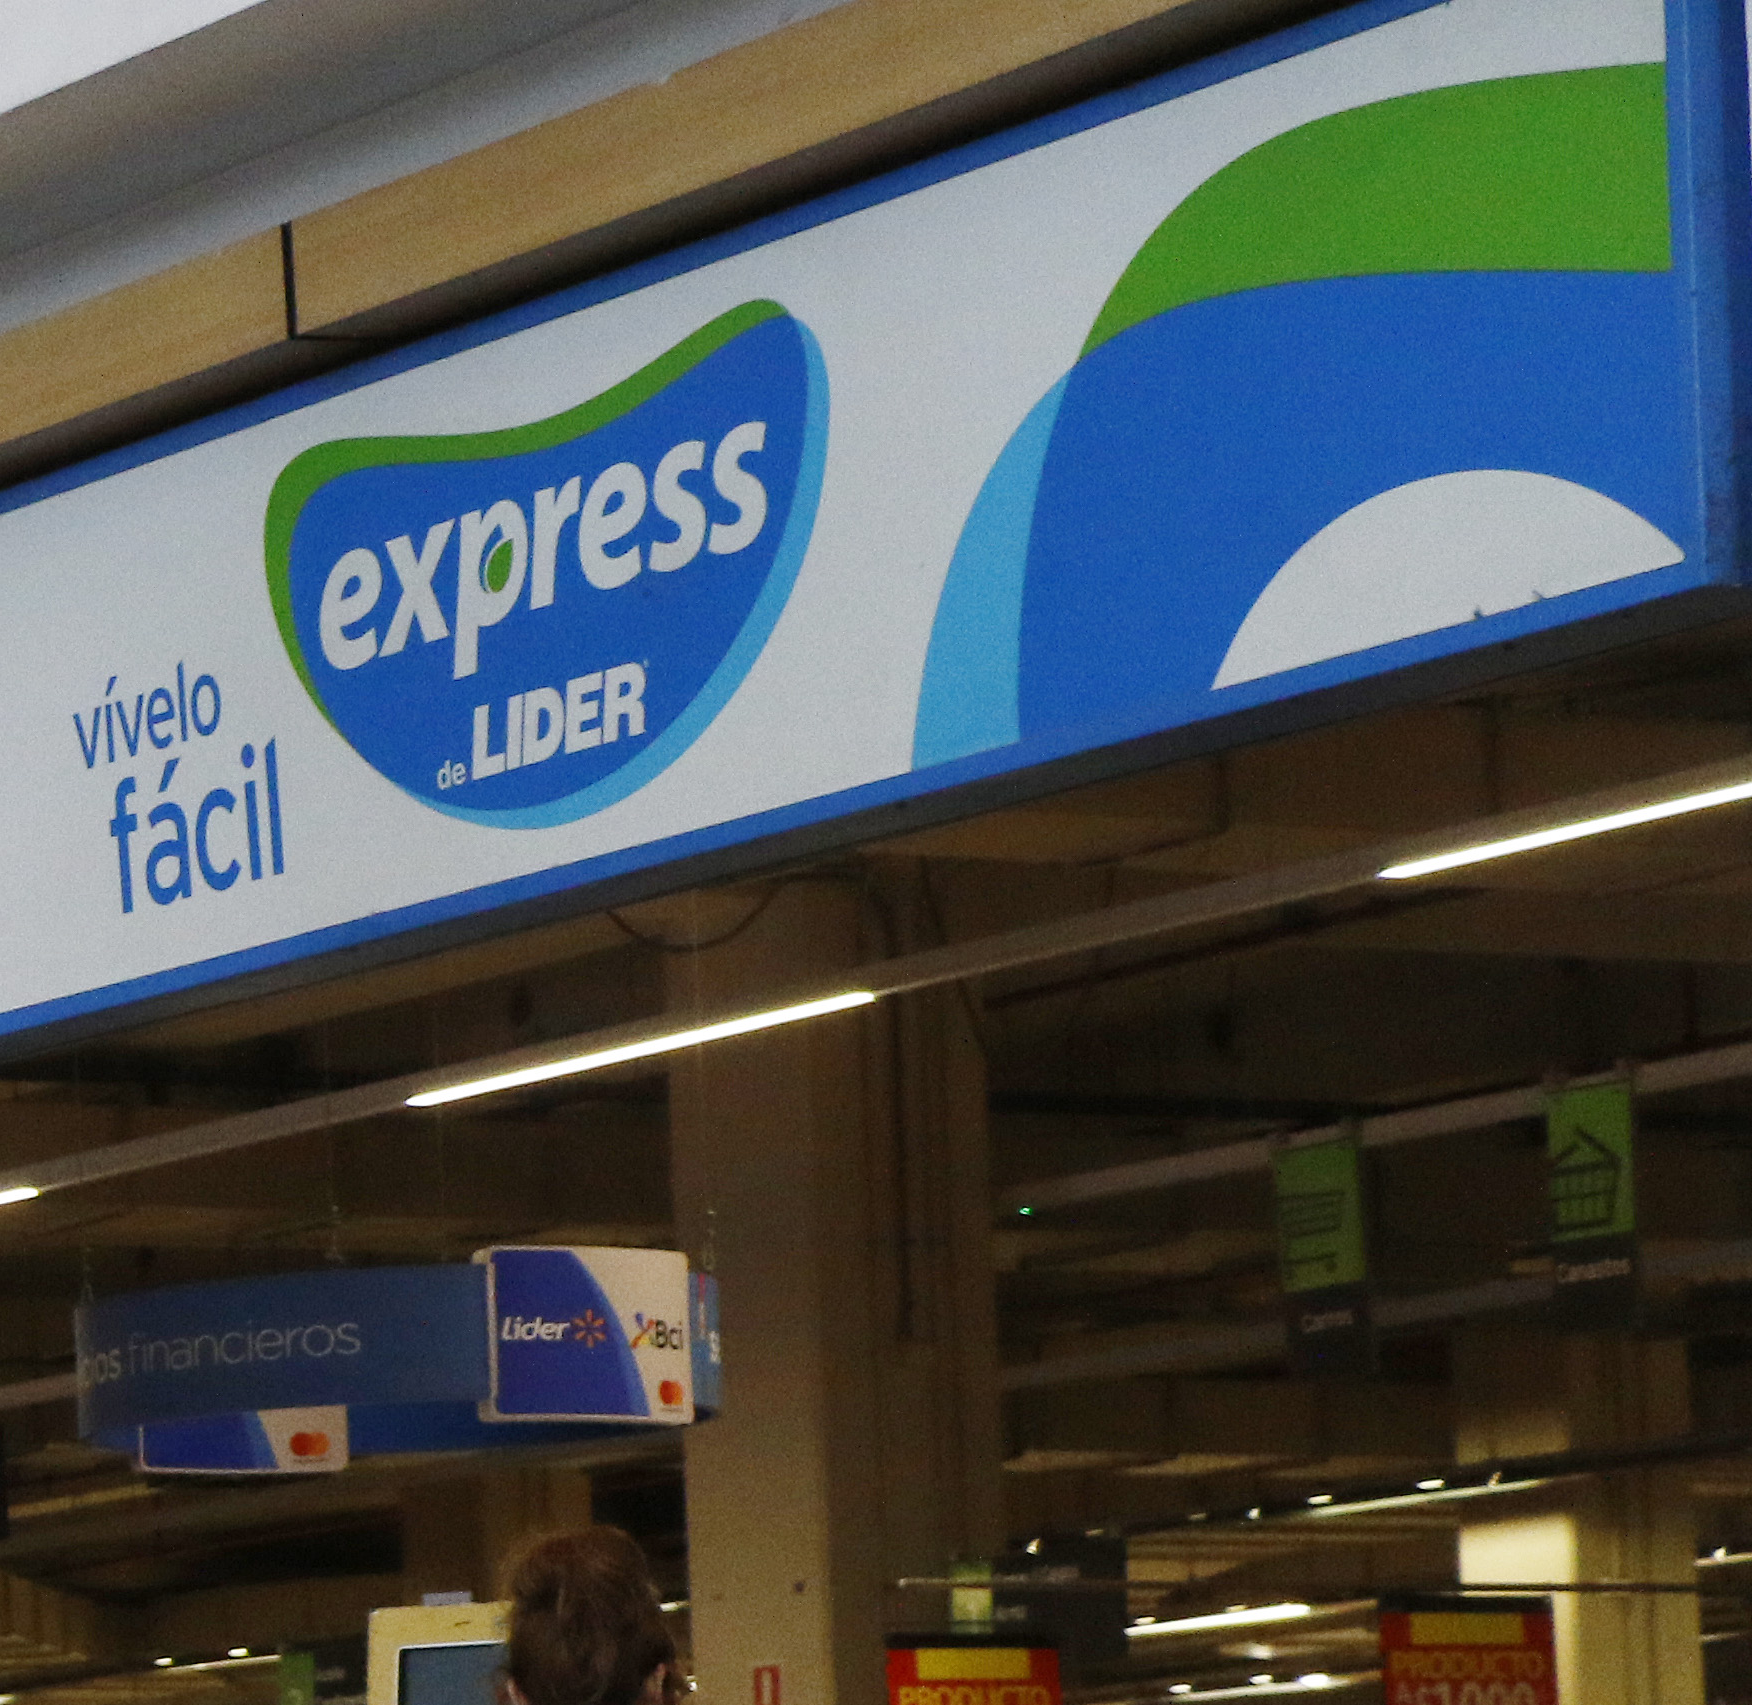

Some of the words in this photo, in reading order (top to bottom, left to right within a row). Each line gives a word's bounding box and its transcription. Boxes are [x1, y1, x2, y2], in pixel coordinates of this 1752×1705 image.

[318, 421, 767, 680] express
[72, 660, 222, 770] vívelo
[436, 760, 467, 791] de
[471, 663, 647, 782] LIDER
[110, 737, 285, 914] fácil
[1391, 1650, 1545, 1680] PRODUCTO
